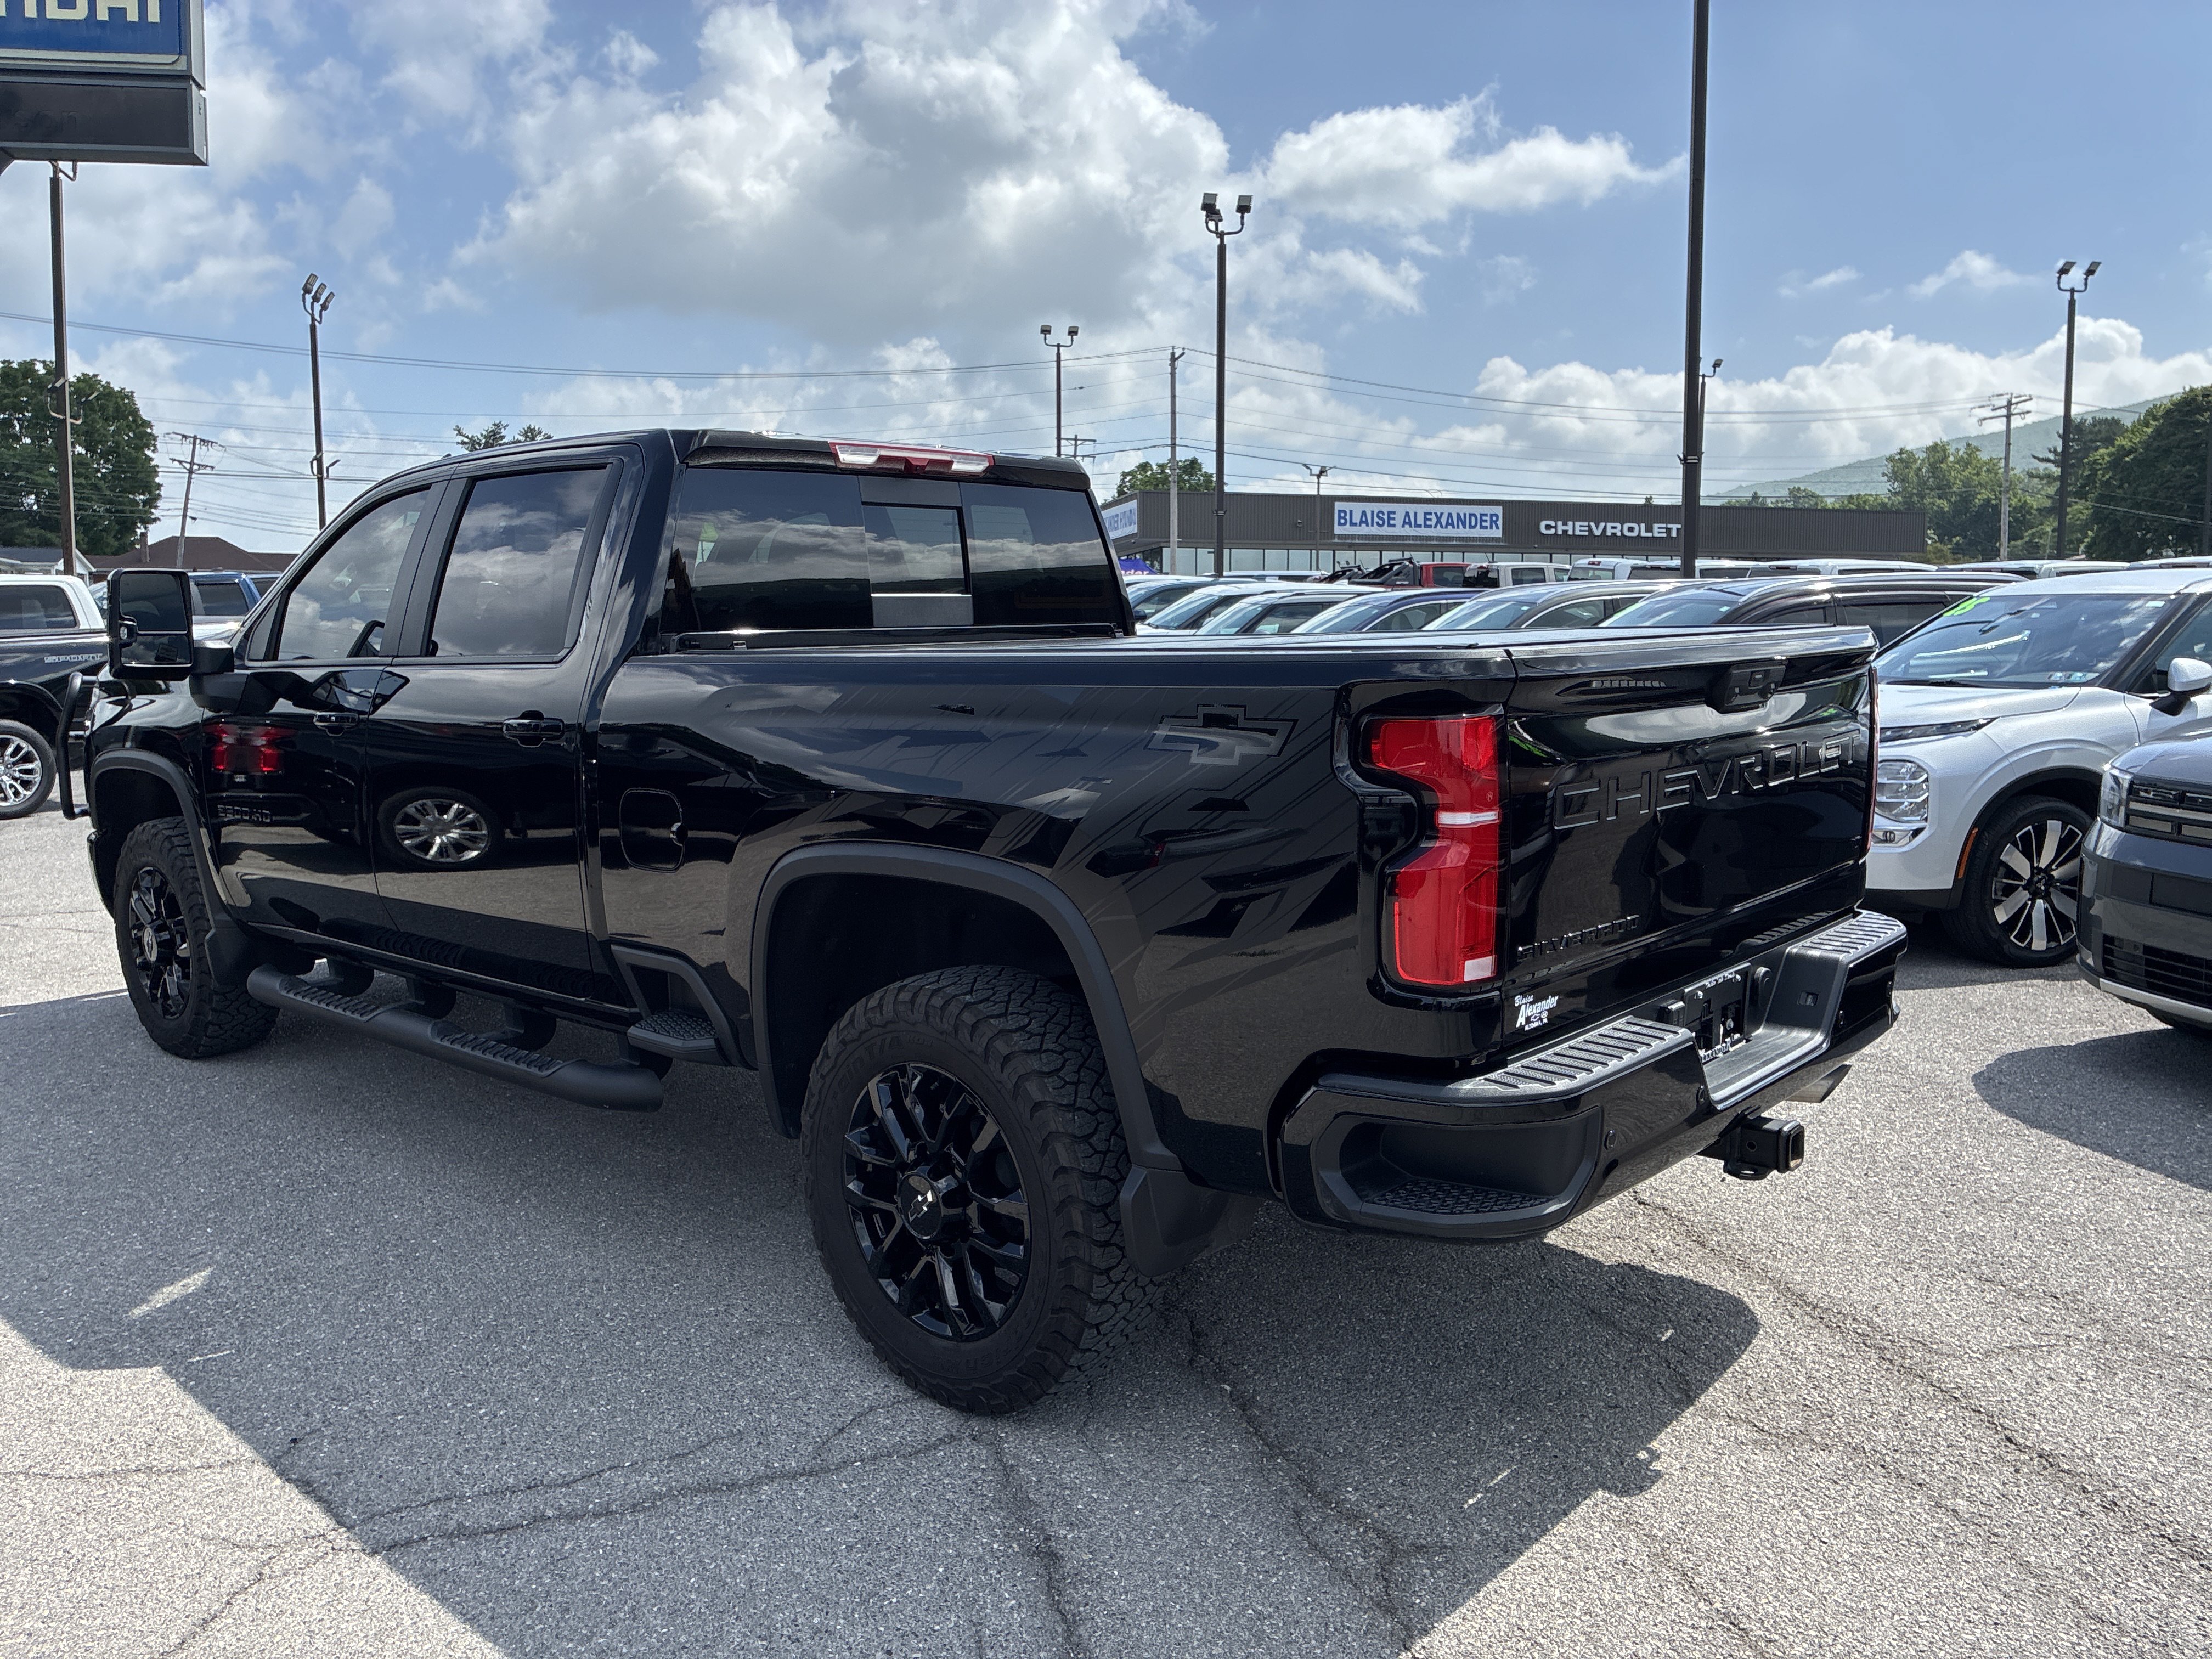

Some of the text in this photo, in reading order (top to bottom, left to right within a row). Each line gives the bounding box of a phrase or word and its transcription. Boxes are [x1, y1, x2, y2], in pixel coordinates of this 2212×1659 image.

[1337, 509, 1500, 530] BLAISE ALEXANDER
[1539, 520, 1681, 538] CHEVROLET
[1554, 729, 1861, 830] CHEVROLET
[1516, 915, 1640, 963] SILVERADO
[1514, 995, 1534, 1007] Blaise
[1516, 995, 1559, 1028] Alexander
